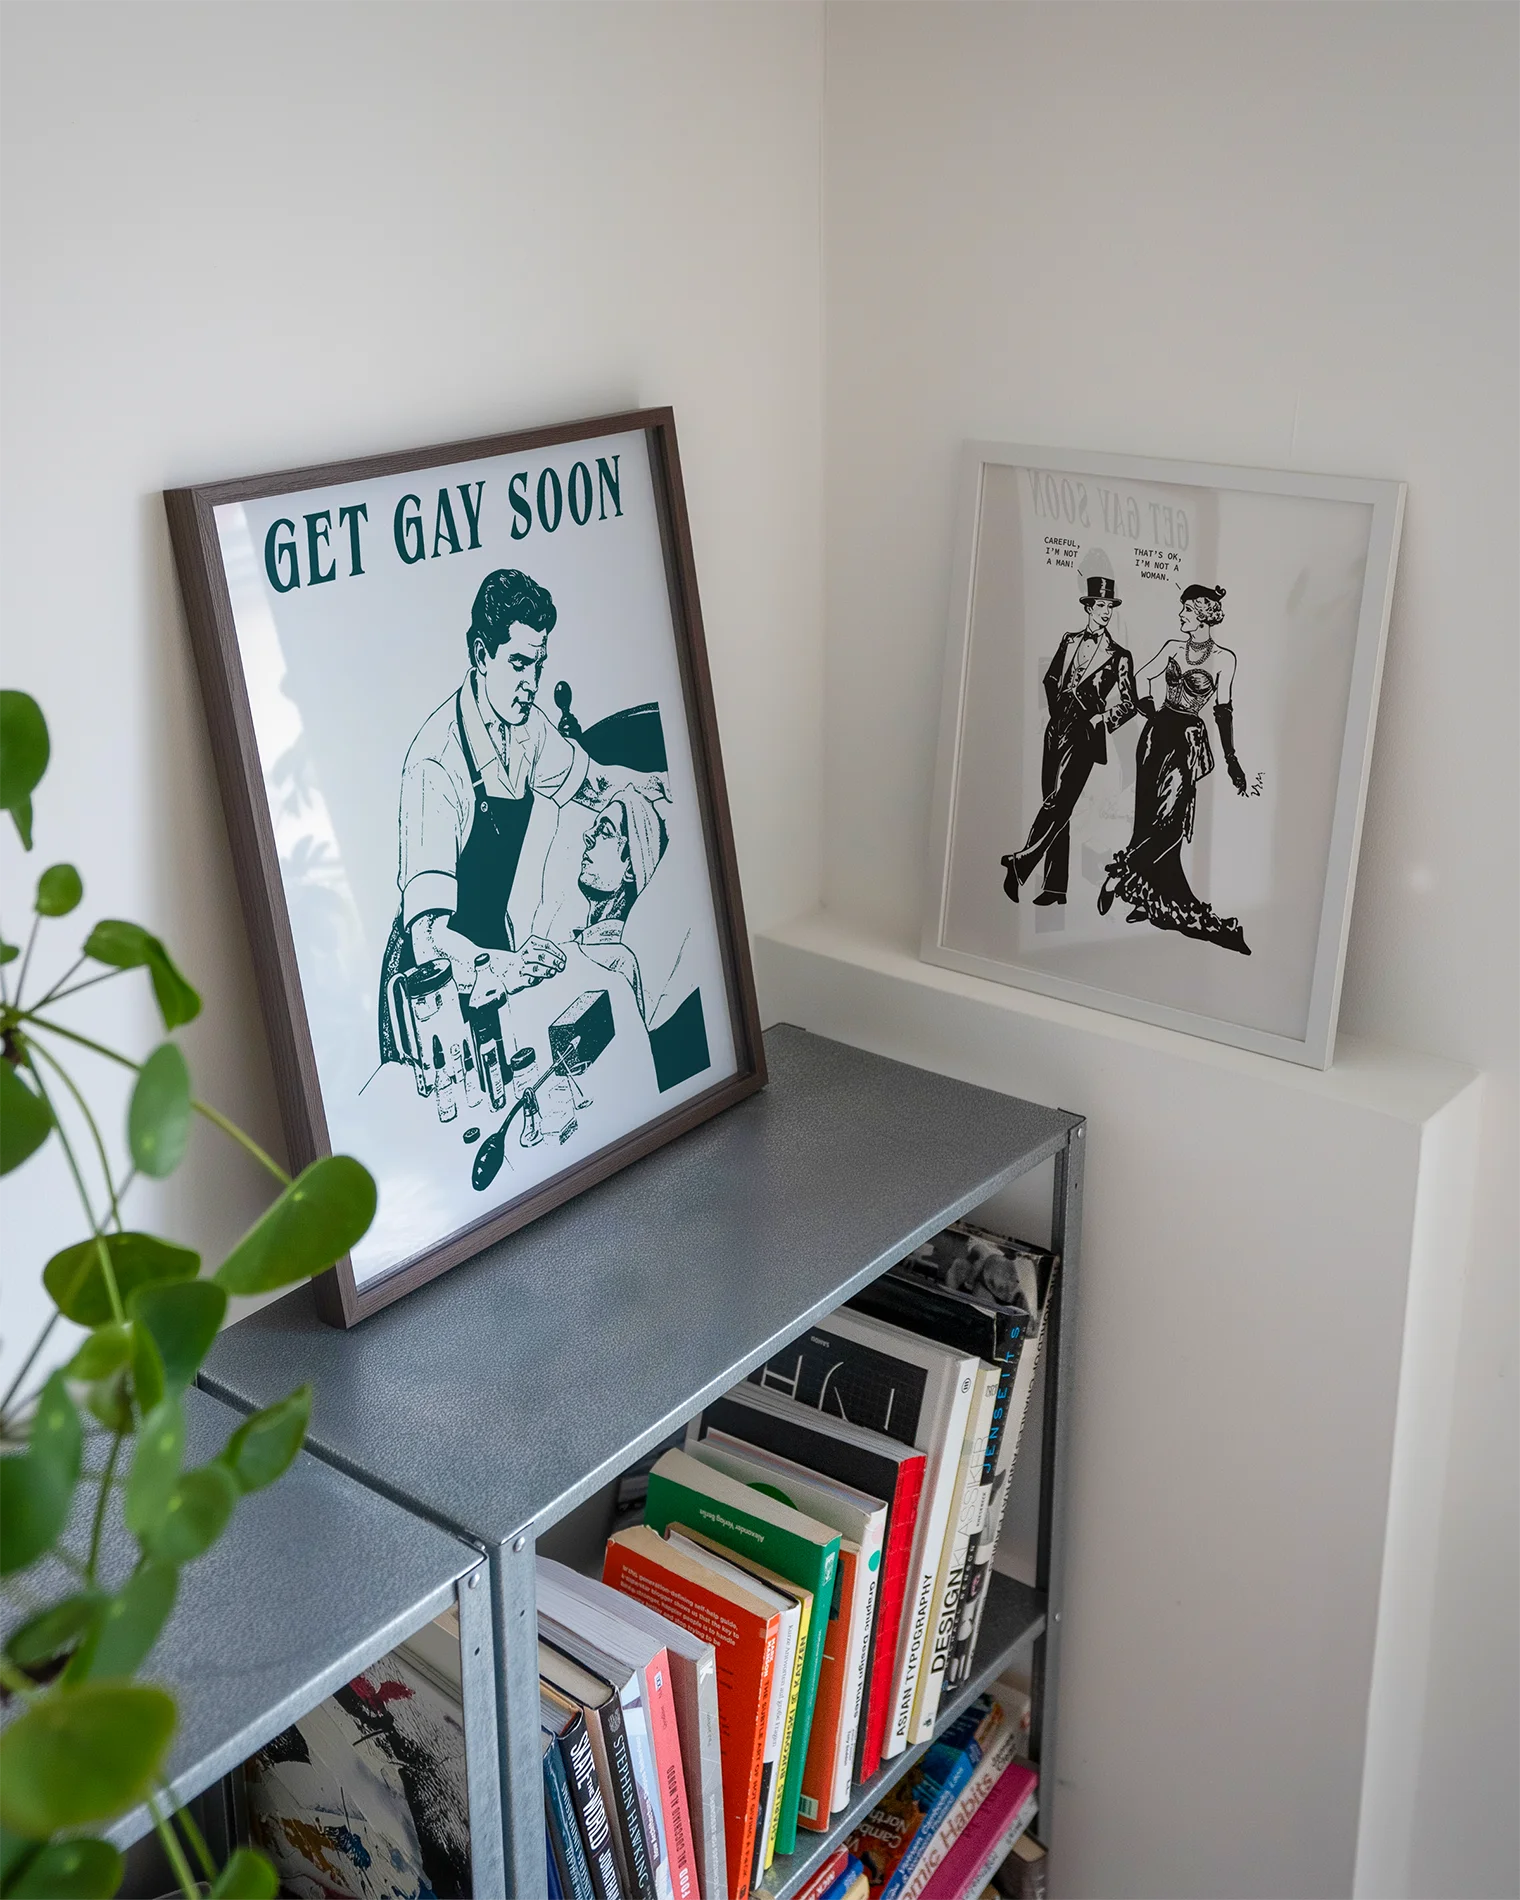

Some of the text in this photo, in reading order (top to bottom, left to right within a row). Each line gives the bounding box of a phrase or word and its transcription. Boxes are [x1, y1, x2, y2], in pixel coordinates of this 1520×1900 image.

[264, 454, 624, 593] GET GAY SOON
[1044, 536, 1081, 549] CAREFUL,
[1045, 547, 1078, 558] I'M NOT
[1134, 548, 1182, 562] THAT'S OK,
[1046, 558, 1075, 568] A MAN!
[1135, 558, 1180, 572] I'M NOT A
[1140, 570, 1170, 582] WOMAN.
[982, 1326, 1021, 1473] JENSEITS
[700, 1508, 764, 1542] Alexander Verlag Berlin
[674, 1600, 690, 1614] shows
[692, 1610, 698, 1618] us
[699, 1612, 711, 1624] that
[712, 1619, 721, 1629] the
[722, 1624, 732, 1636] key
[733, 1631, 740, 1639] to
[705, 1634, 712, 1642] to
[713, 1637, 720, 1646] be
[708, 1626, 715, 1635] to
[716, 1630, 735, 1646] handle
[853, 1581, 876, 1719] Graphic Design Rules
[782, 1647, 790, 1686] Antworten
[794, 1636, 806, 1688] KATZEN
[896, 1573, 932, 1736] ASIAN TYPOGRAPHY
[772, 1722, 780, 1748] Fragen
[666, 1764, 678, 1797] MONDO
[754, 1764, 760, 1776] OF
[770, 1708, 796, 1841] CHARLES BUKOWSKI
[570, 1730, 610, 1850] SKATE THE WORLD
[670, 1794, 679, 1808] AL
[614, 1734, 634, 1810] STEPHEN
[627, 1808, 649, 1888] HAWKING
[746, 1803, 756, 1840] GIVING
[869, 1810, 908, 1833] North
[940, 1773, 994, 1849] Habits
[858, 1824, 902, 1848] Camb
[678, 1850, 687, 1869] DAL
[902, 1848, 941, 1900] omic
[679, 1867, 690, 1899] FOOD
